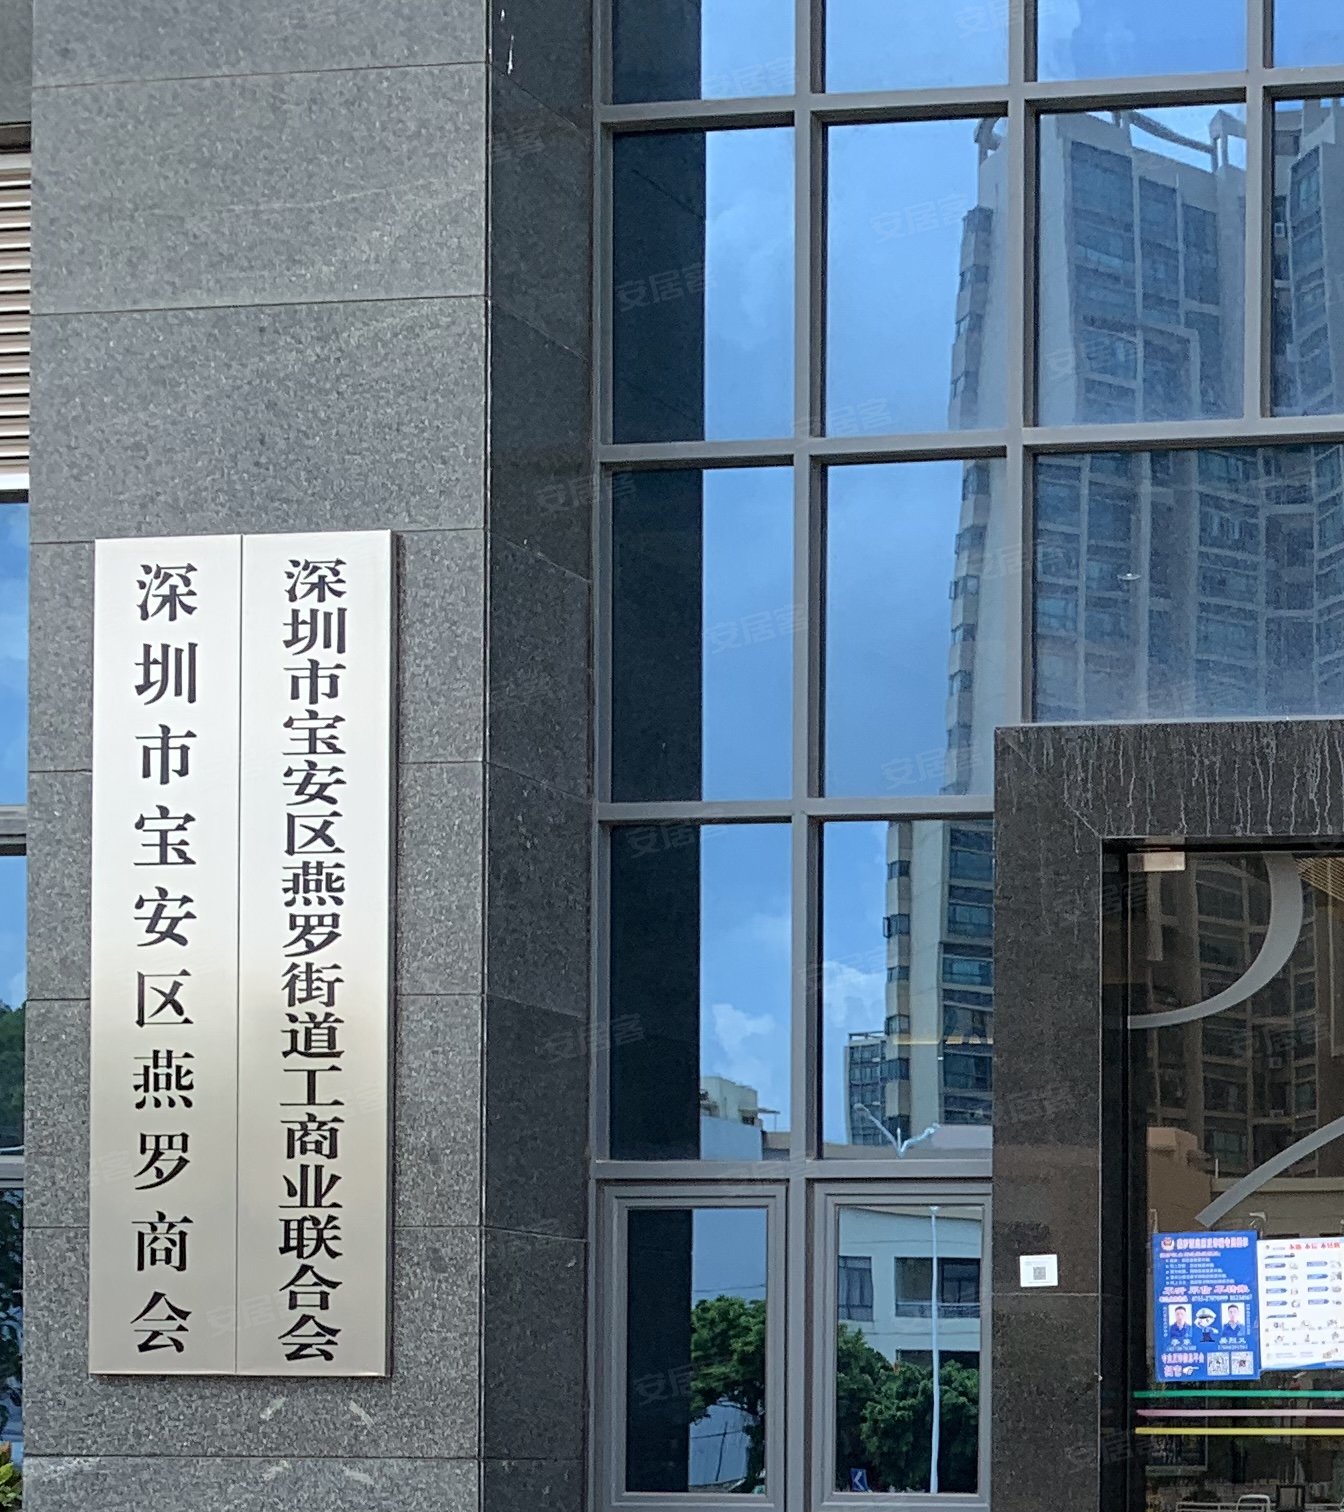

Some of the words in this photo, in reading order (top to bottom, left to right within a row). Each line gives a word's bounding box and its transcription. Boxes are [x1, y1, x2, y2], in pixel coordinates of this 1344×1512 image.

[131, 561, 199, 1356] 深圳市宝安区燕罗商会
[278, 557, 348, 1363] 深圳市宝安区燕罗街道工商业联合会
